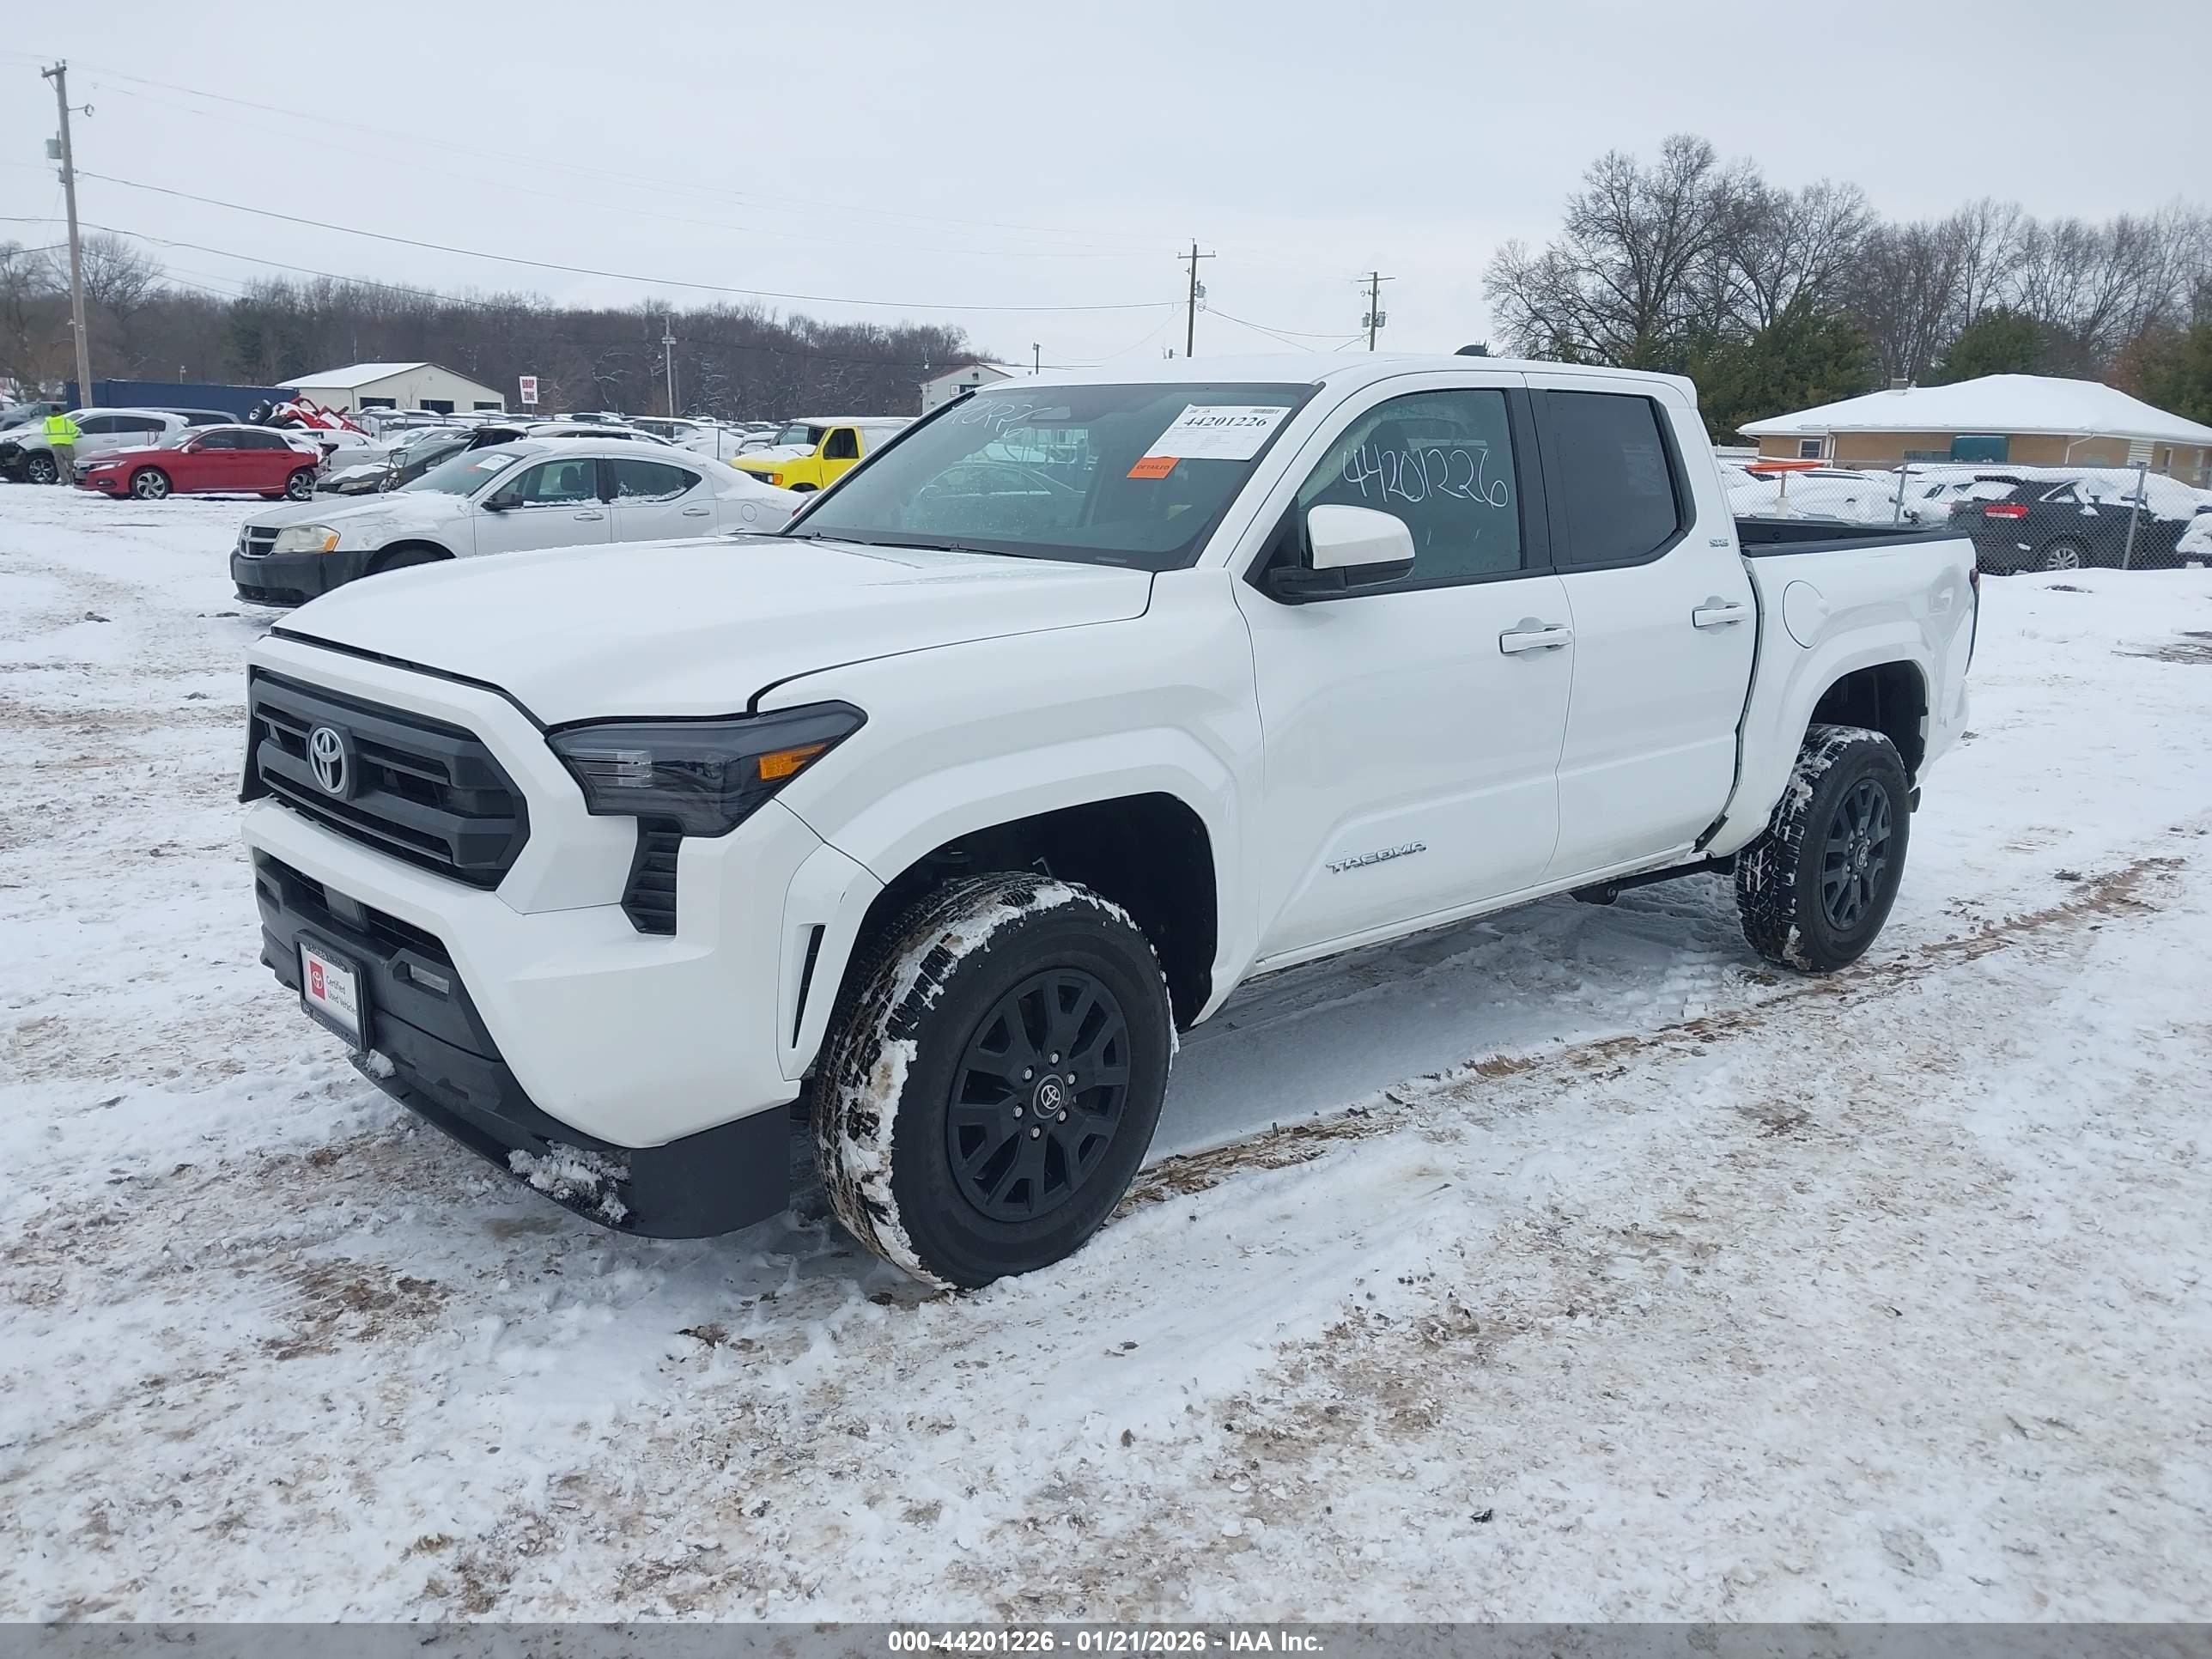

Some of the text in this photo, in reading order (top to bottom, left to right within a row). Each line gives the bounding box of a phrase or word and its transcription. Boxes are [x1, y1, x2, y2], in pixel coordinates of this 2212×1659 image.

[1184, 416, 1270, 427] 44201226
[1342, 444, 1509, 510] 44201226
[1326, 840, 1427, 874] TACOMA
[325, 975, 346, 995] Certified
[327, 988, 339, 1004] Used
